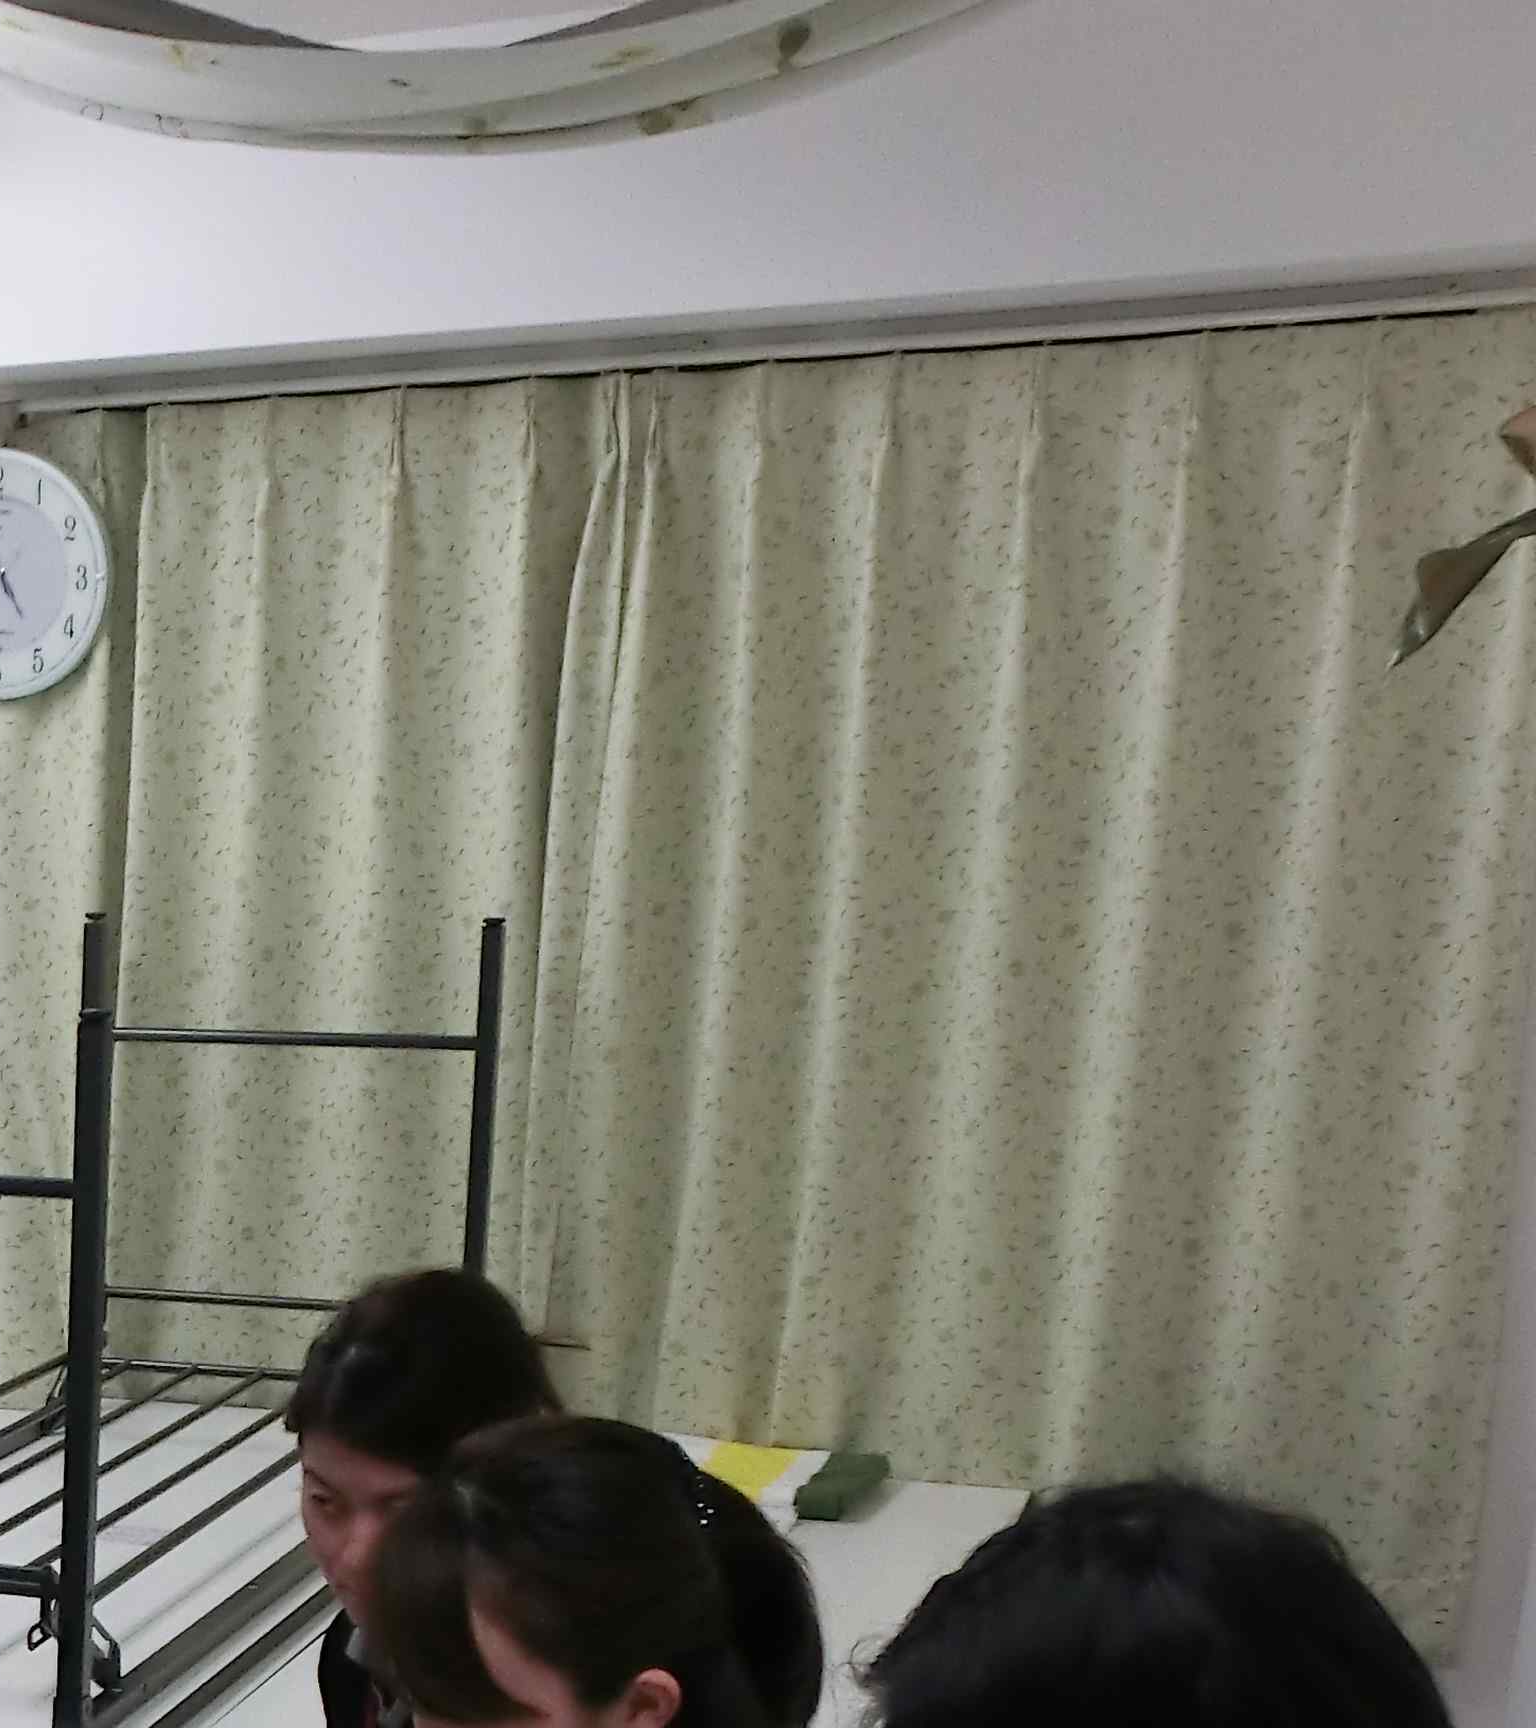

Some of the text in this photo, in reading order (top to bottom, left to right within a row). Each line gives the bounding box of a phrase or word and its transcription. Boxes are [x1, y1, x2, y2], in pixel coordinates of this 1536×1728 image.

[63, 515, 77, 542] 2
[75, 564, 88, 591] 3
[63, 612, 75, 639] 4
[31, 647, 44, 674] 5
